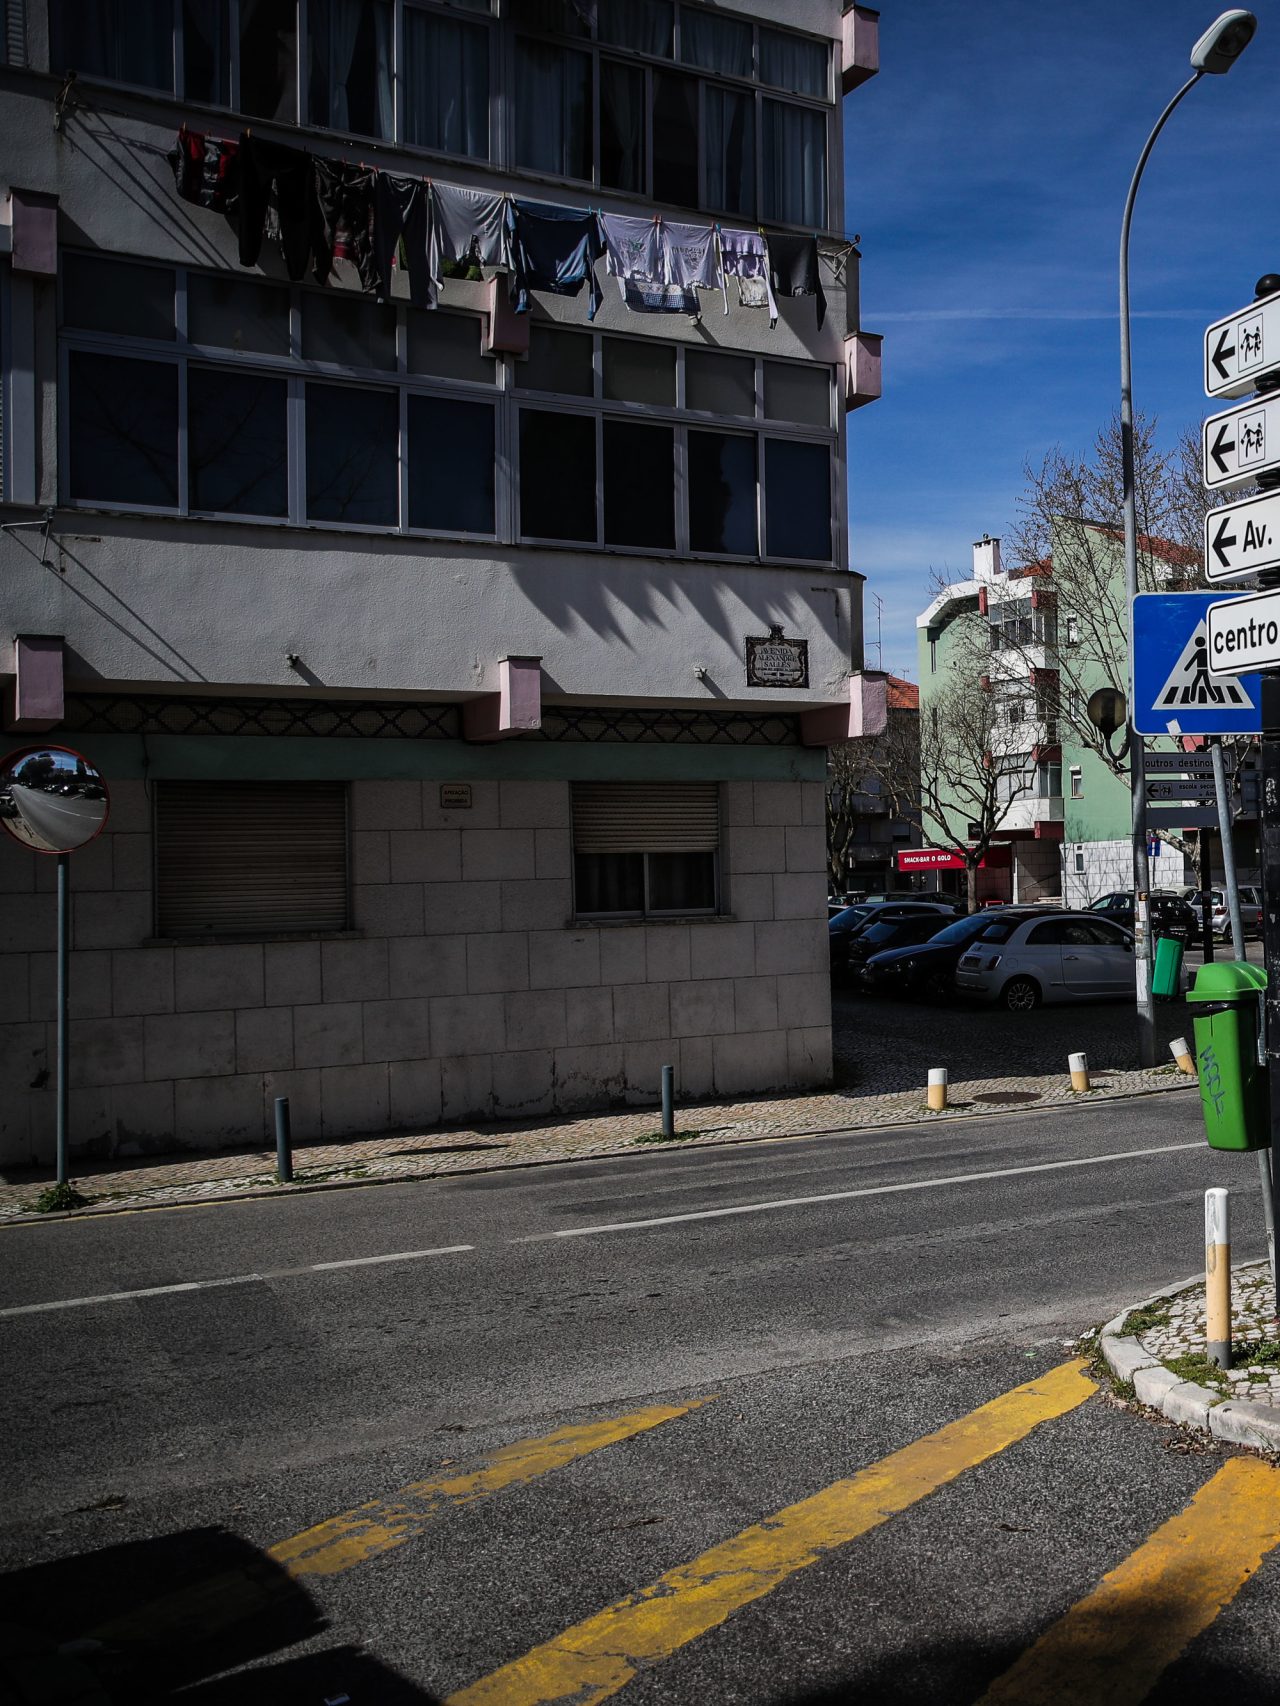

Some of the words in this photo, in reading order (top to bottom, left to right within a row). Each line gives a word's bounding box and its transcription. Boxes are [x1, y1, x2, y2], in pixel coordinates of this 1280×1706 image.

[1242, 519, 1273, 553] Av.
[1214, 617, 1279, 654] centro
[761, 647, 793, 655] AVENIDA
[1145, 759, 1173, 767] outros
